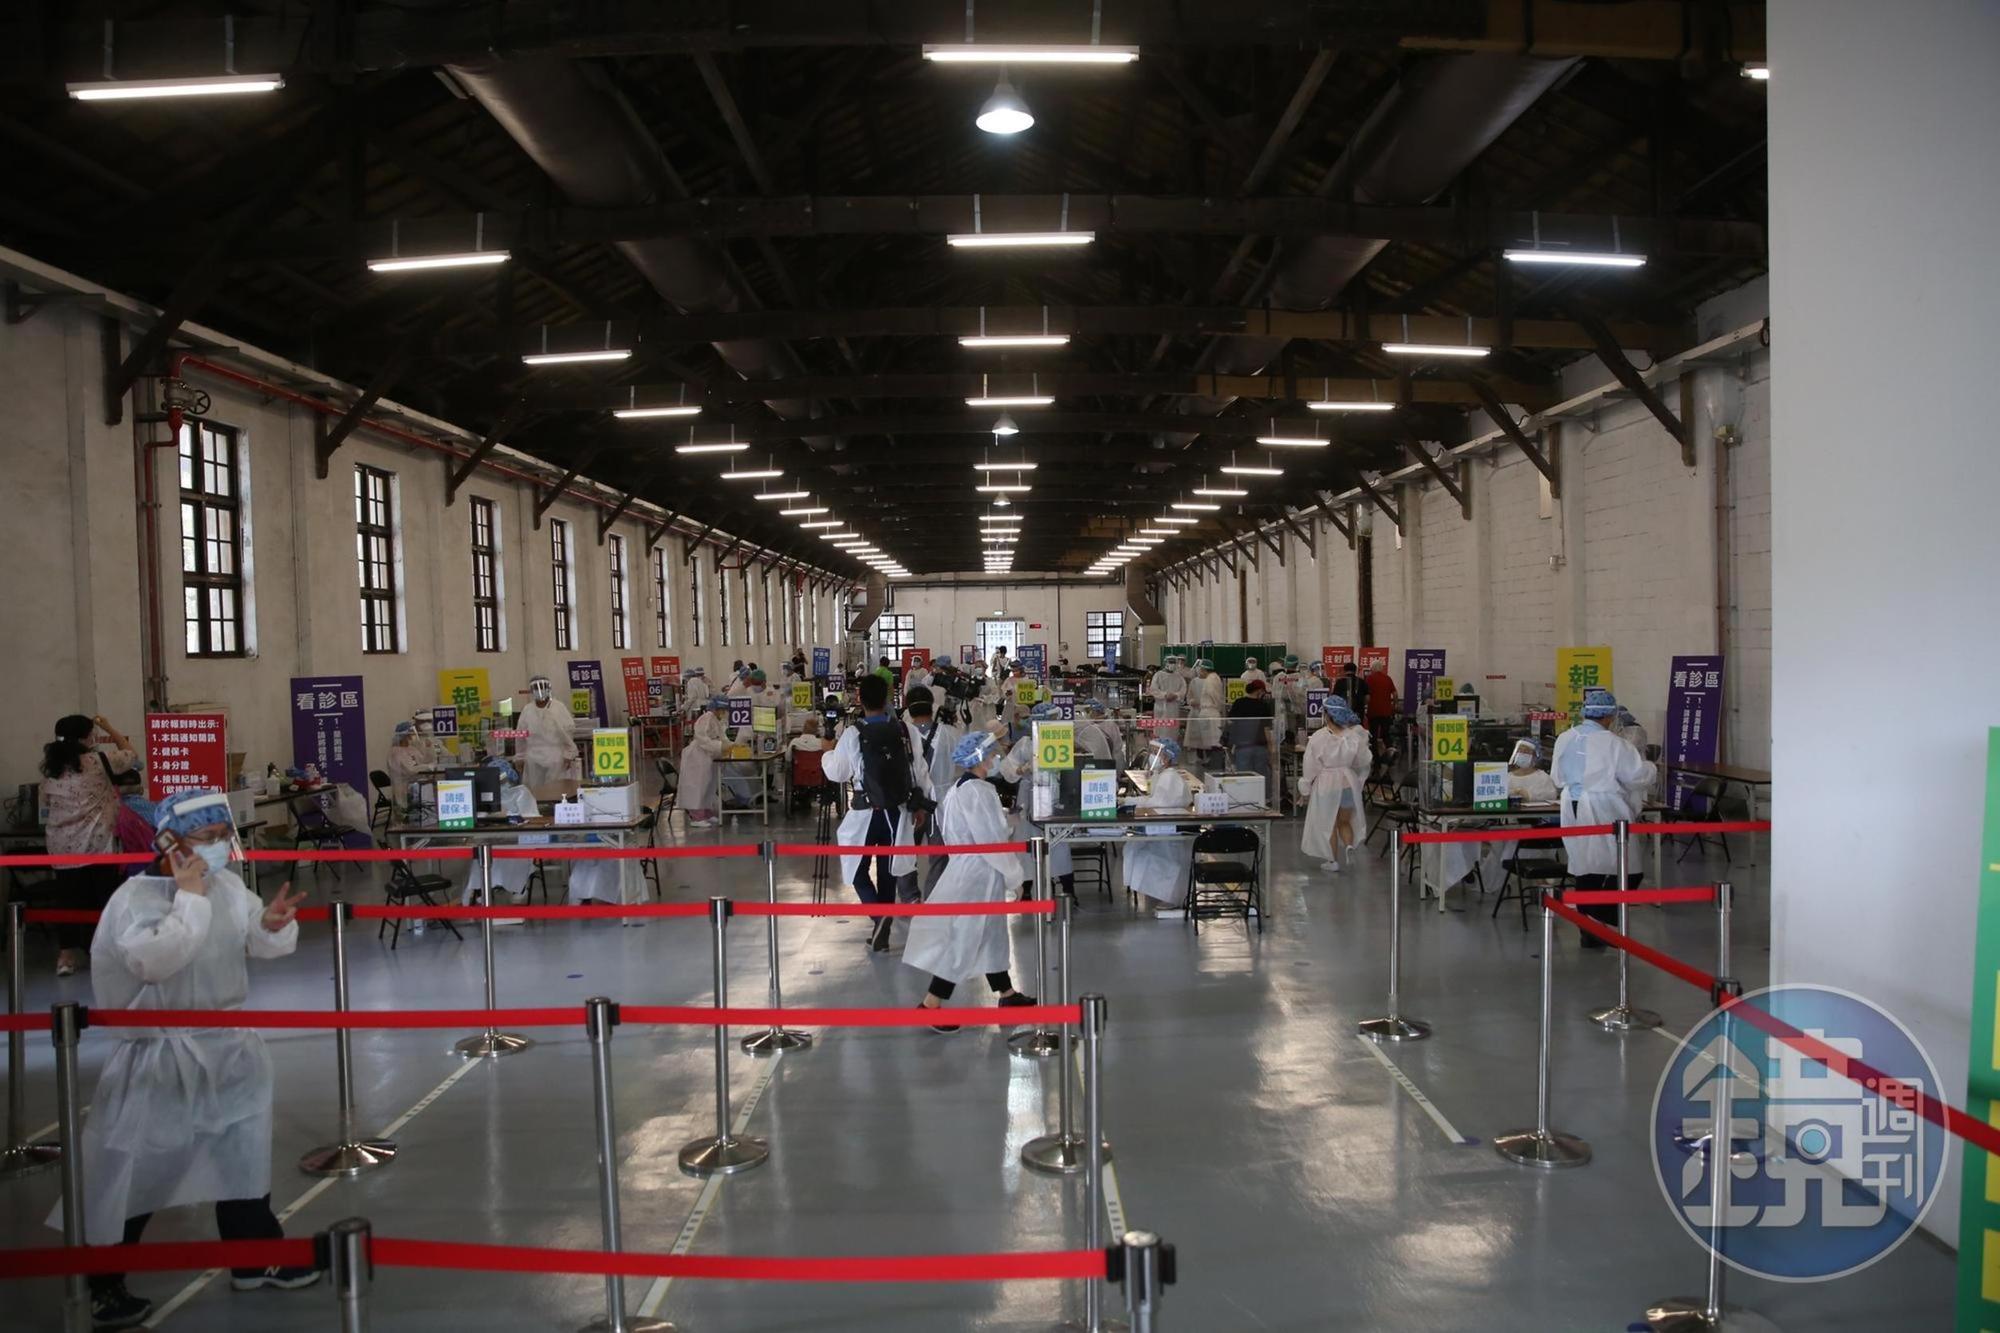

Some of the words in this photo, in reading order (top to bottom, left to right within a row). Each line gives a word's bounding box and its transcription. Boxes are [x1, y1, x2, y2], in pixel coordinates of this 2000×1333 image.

[1408, 658, 1443, 669] 看診區
[571, 669, 600, 681] 看診區
[1673, 670, 1720, 688] 看診區
[648, 685, 661, 695] 06
[828, 681, 841, 691] 07
[1019, 691, 1034, 701] 08
[1438, 687, 1452, 698] 10
[297, 691, 359, 711] 看診區
[794, 694, 809, 705] 07
[573, 700, 588, 711] 06
[731, 710, 750, 723] 02
[437, 720, 455, 733] 01
[152, 747, 190, 756] 2.健保卡
[1437, 737, 1464, 755] 04
[1044, 744, 1071, 763] 03
[598, 751, 625, 770] 02
[1480, 774, 1500, 784] 請插
[1088, 781, 1108, 792] 請插
[1476, 785, 1506, 796] 健保卡
[445, 792, 465, 803] 請插
[1084, 793, 1114, 804] 健保卡
[440, 804, 471, 815] 健保卡
